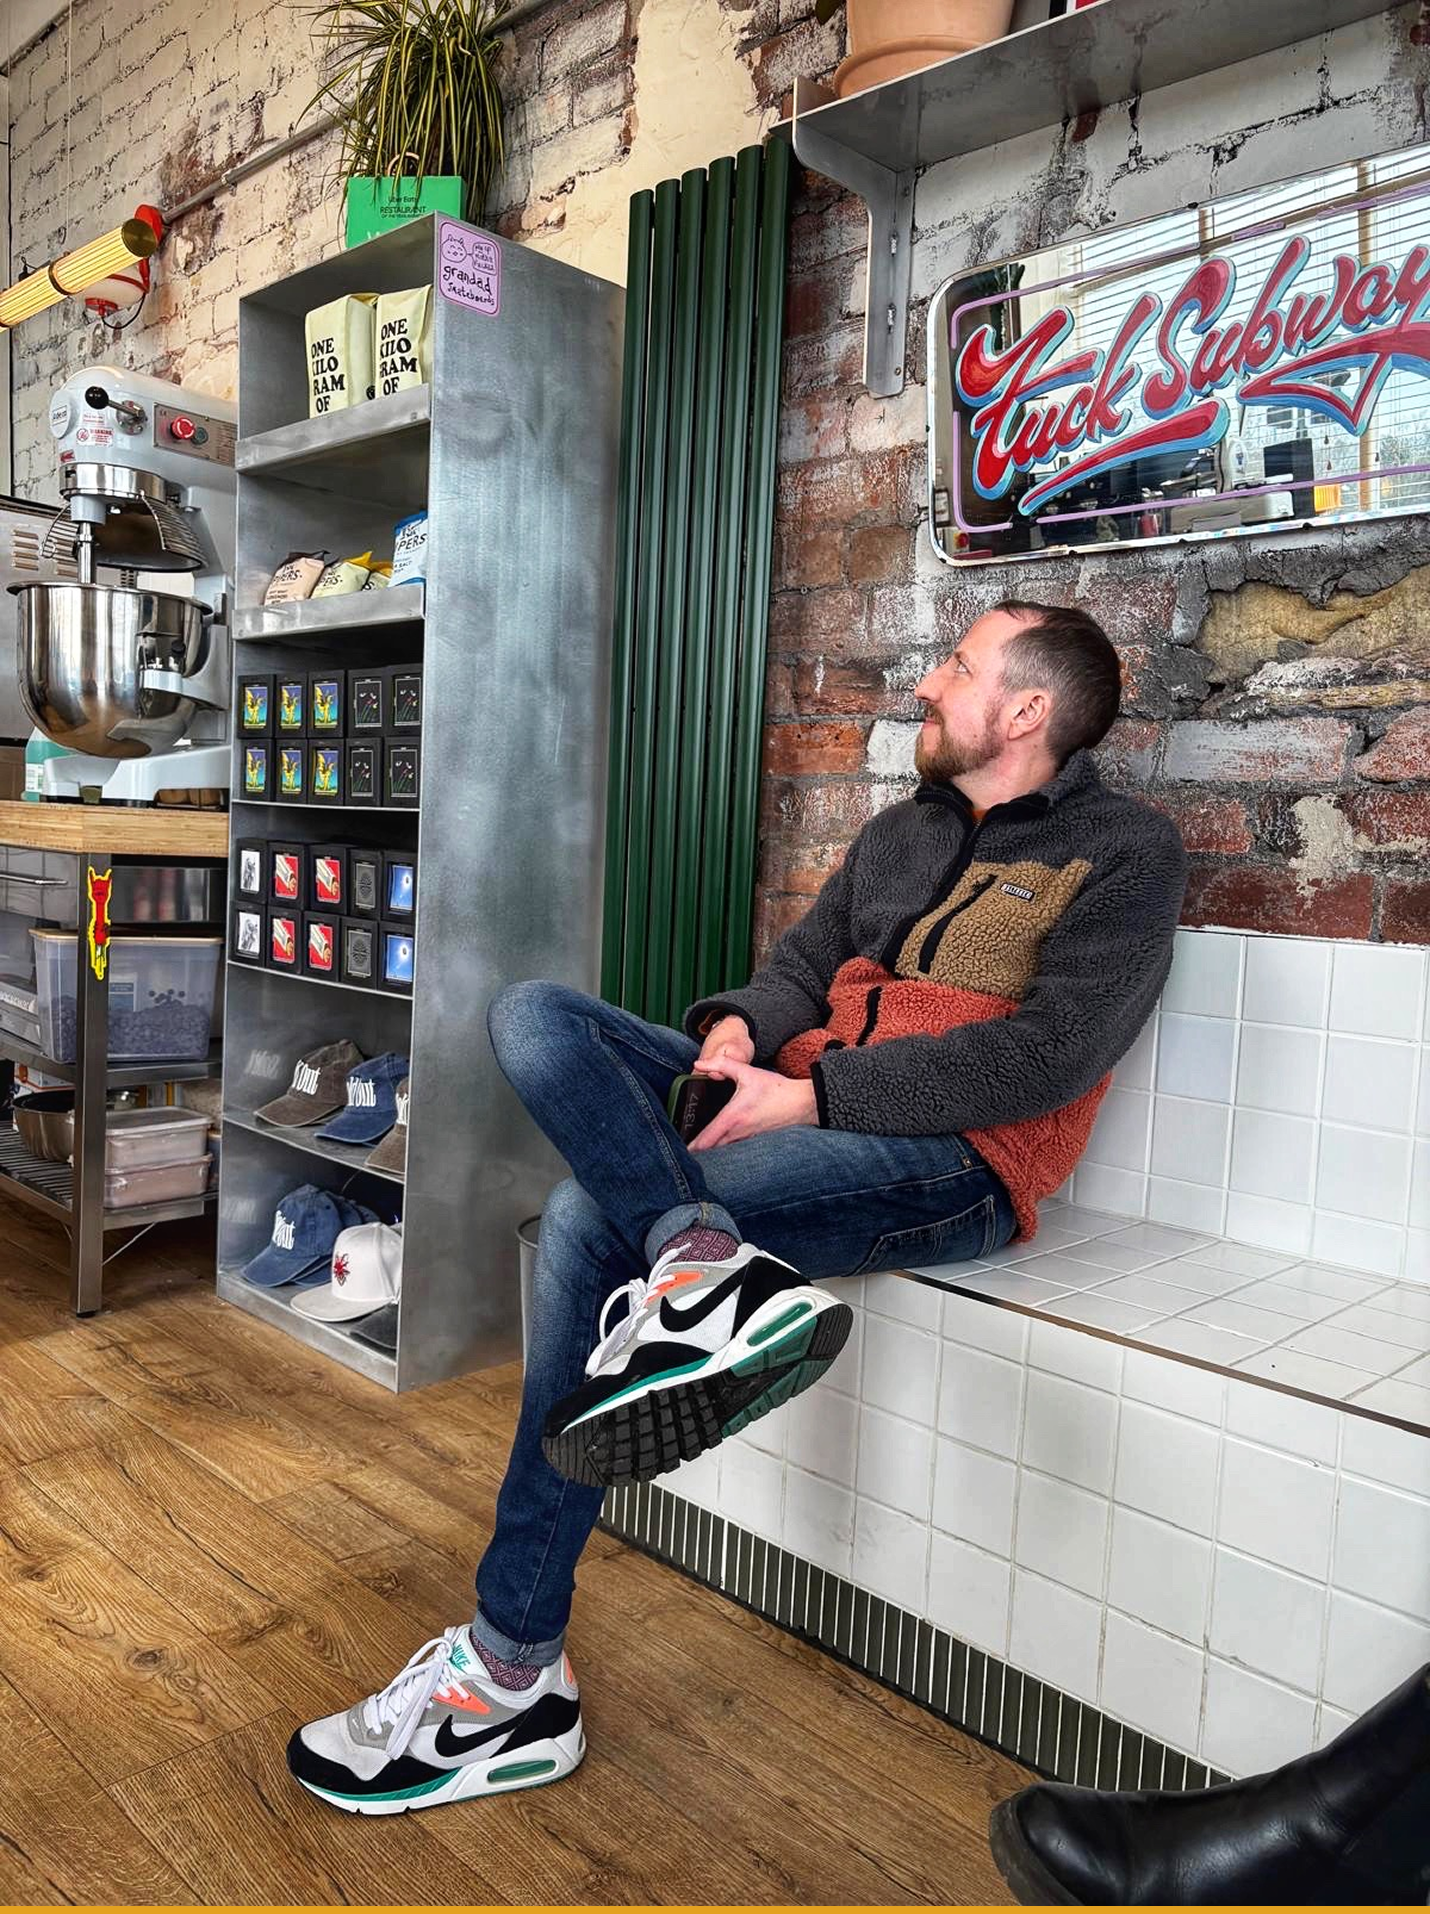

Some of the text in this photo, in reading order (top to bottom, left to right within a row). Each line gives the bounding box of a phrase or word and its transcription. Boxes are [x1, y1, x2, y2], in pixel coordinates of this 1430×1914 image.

[443, 265, 493, 296] grandad
[380, 318, 408, 341] ONE
[311, 337, 335, 359] ONE
[312, 356, 339, 377] ILO
[380, 356, 418, 378] RAM
[313, 374, 346, 396] RAM
[383, 376, 400, 396] OF
[955, 292, 1162, 500] Fuck
[316, 395, 331, 413] OF
